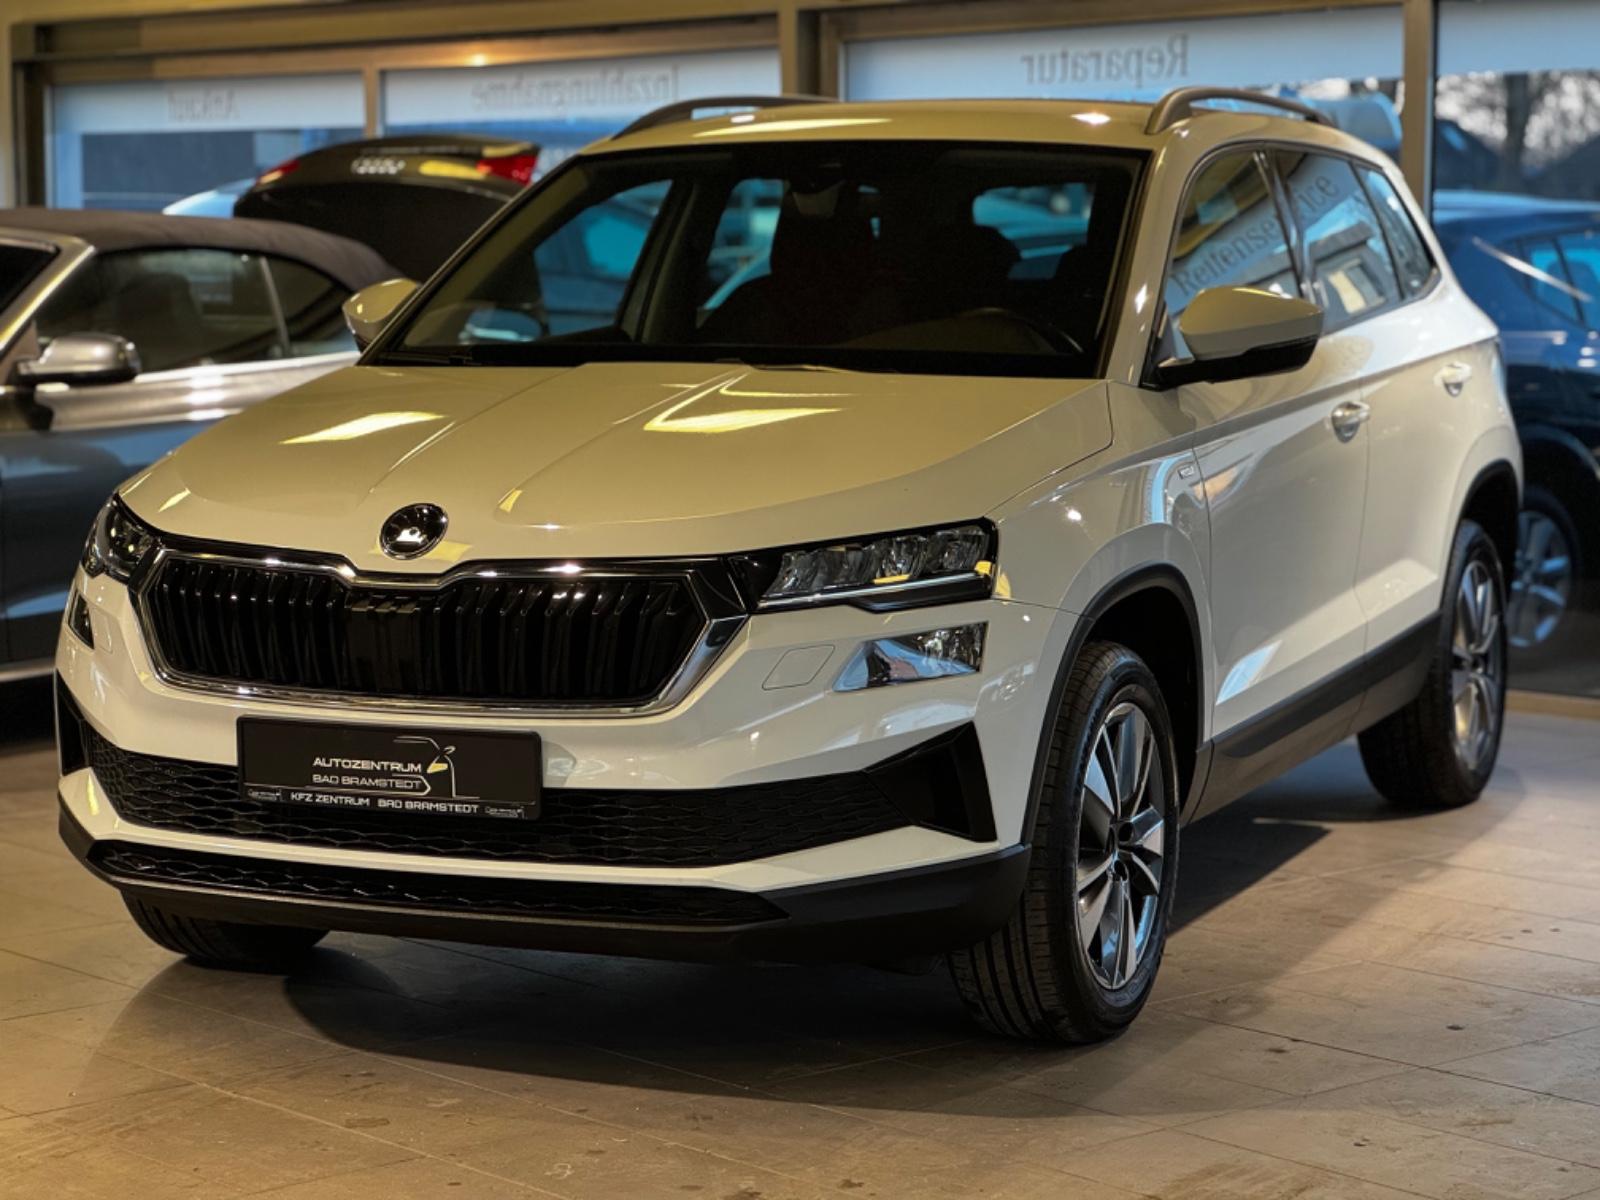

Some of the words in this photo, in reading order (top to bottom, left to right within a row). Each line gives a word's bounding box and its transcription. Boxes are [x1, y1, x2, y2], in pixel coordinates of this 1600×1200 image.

[1170, 175, 1340, 297] Reifenseice
[313, 757, 422, 773] AUTOZENTRUM
[312, 774, 339, 785] BAD
[341, 776, 421, 790] BRAMSTEDT
[291, 792, 313, 802] KFZ
[315, 793, 370, 806] ZENTRUM
[377, 799, 403, 809] BAD
[404, 800, 479, 813] BRAMSTEDT
